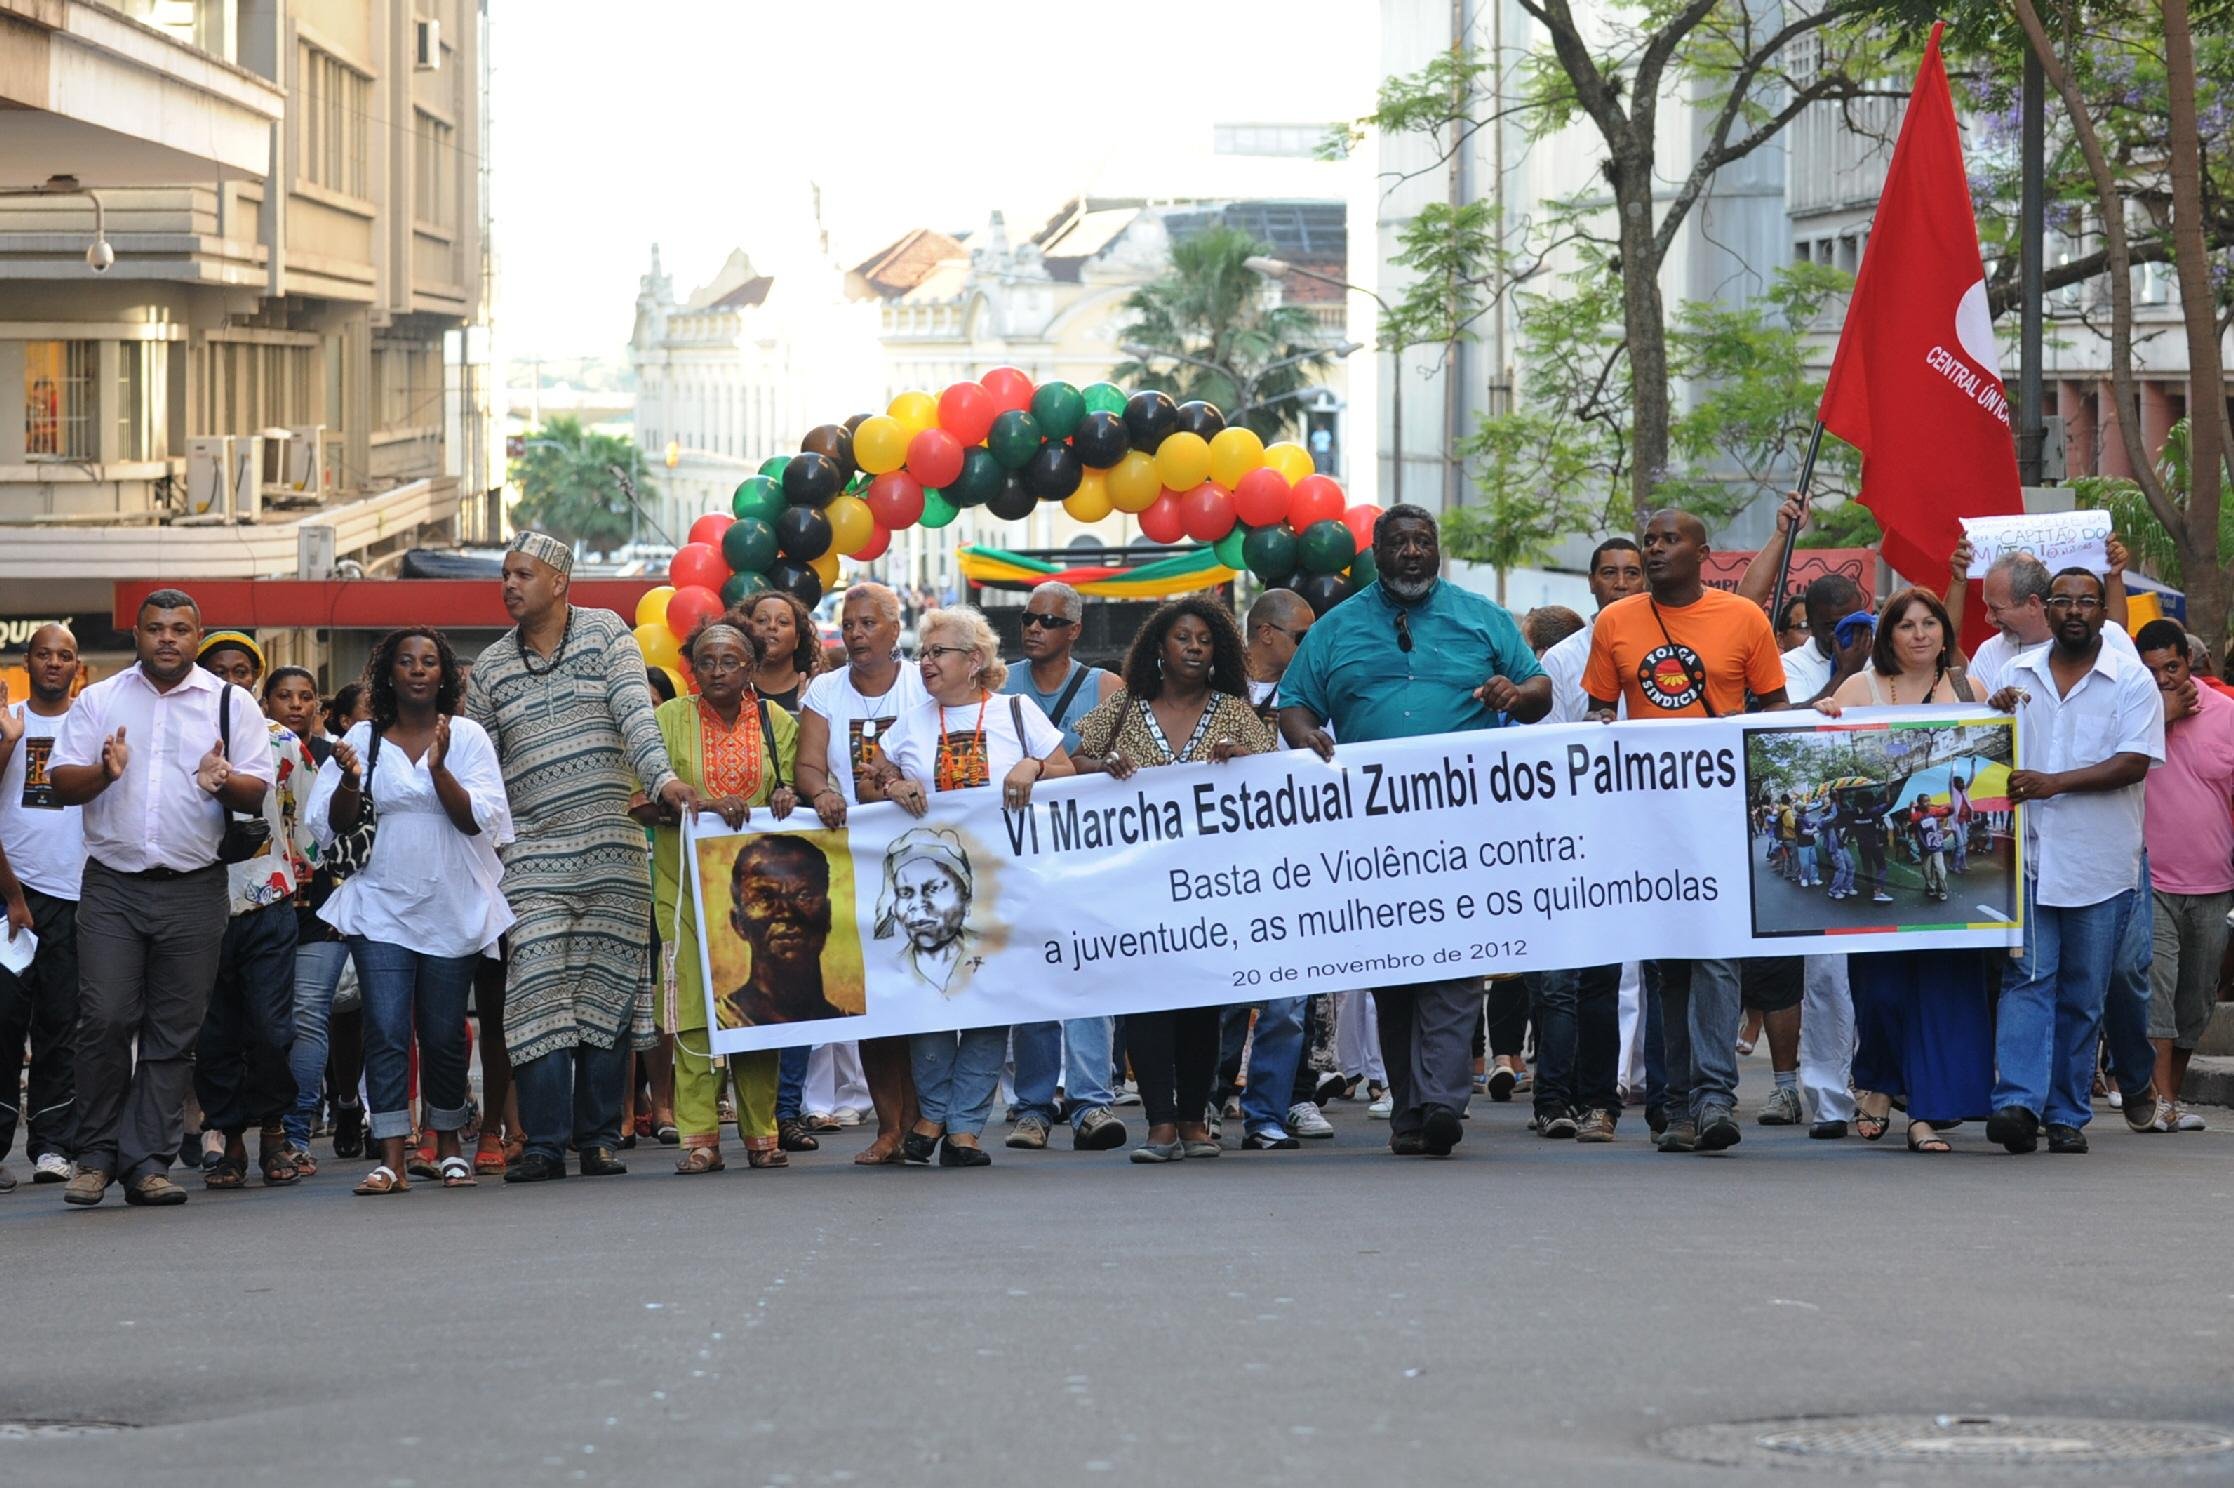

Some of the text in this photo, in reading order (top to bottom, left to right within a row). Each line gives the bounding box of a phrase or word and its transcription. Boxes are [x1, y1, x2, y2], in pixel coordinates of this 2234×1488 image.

[1926, 346, 1981, 398] CENTRAL
[2001, 526, 2077, 546] CAPITÃO
[2082, 527, 2107, 541] DO
[1000, 740, 1737, 857] VI Marcha Estadual Zumbi dos Palmares
[1169, 831, 1586, 903] Basta de Violência contra:
[1044, 868, 1718, 972] a juventude, as mulheres e os quilombolas
[1232, 939, 1528, 988] 20 de novembro de 2012
